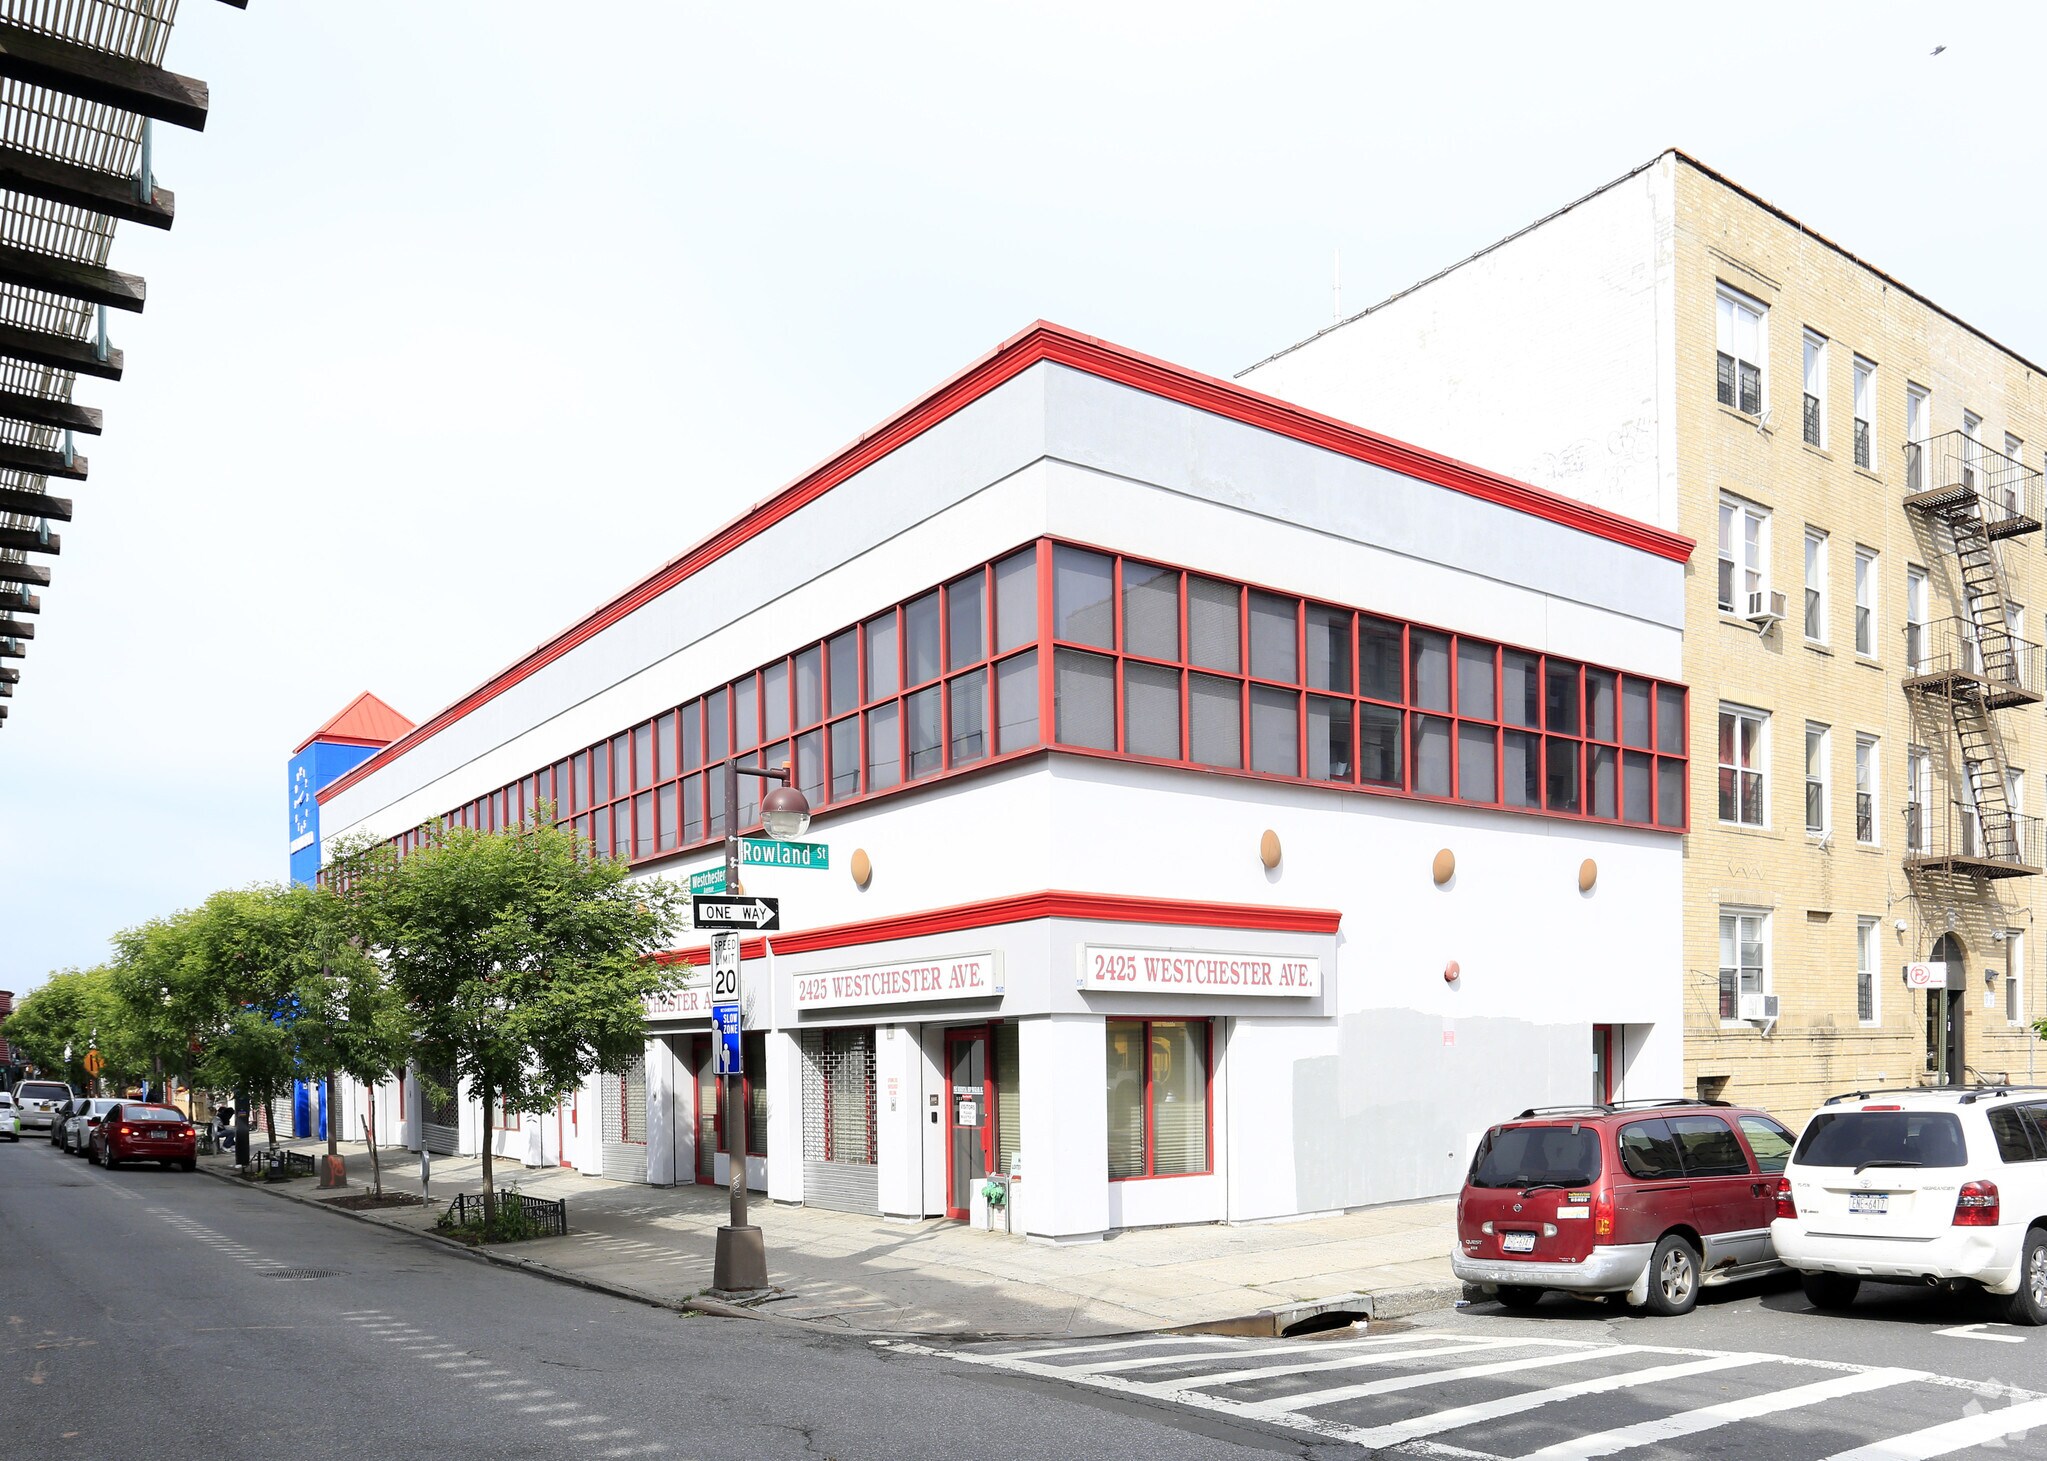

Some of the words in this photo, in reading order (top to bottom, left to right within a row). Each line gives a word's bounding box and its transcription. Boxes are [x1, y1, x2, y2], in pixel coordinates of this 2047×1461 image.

[743, 841, 811, 865] Rowland
[817, 847, 826, 859] St
[692, 869, 726, 889] Westchester
[706, 906, 732, 919] ONE
[742, 907, 767, 920] WAY
[714, 939, 736, 952] SPEED
[715, 953, 735, 966] LIMIT
[1095, 954, 1137, 982] 2425
[1144, 957, 1273, 986] WESTCHESTER
[1279, 963, 1313, 987] AVE.
[715, 969, 736, 995] 20
[799, 978, 827, 1001] 2425
[832, 966, 942, 998] WESTCHESTER
[948, 962, 985, 989] AVE.
[643, 987, 699, 1014] CHESTER
[723, 1013, 738, 1024] SLOW
[723, 1024, 738, 1035] ZONE
